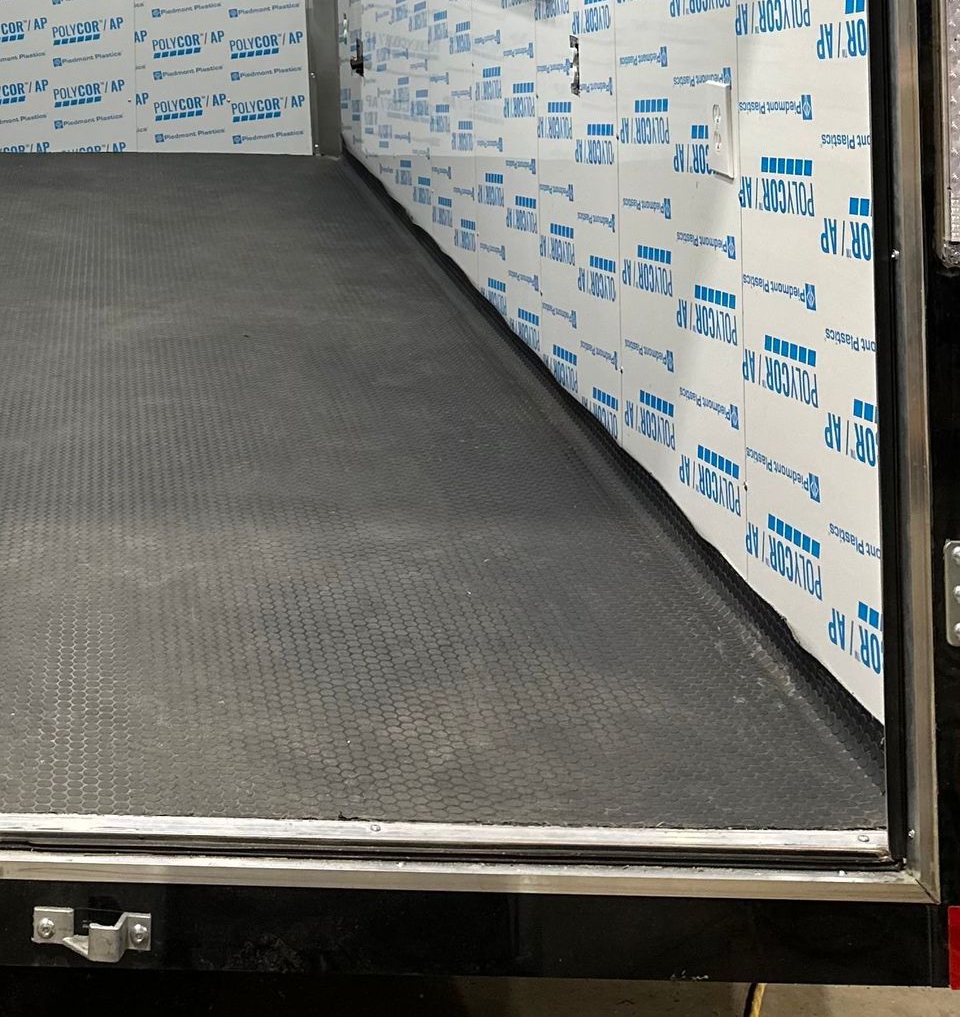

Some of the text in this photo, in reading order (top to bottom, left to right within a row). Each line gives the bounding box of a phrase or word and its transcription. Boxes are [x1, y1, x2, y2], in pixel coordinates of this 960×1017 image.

[619, 51, 660, 68] Piedmont Plastics
[242, 132, 273, 141] Piedmont
[821, 134, 856, 150] Plastics
[676, 231, 726, 252] Piedmont Plastics
[742, 273, 804, 302] Piedmont Plastics
[825, 327, 860, 352] Plastics
[745, 446, 808, 491] Piedmont Plastics
